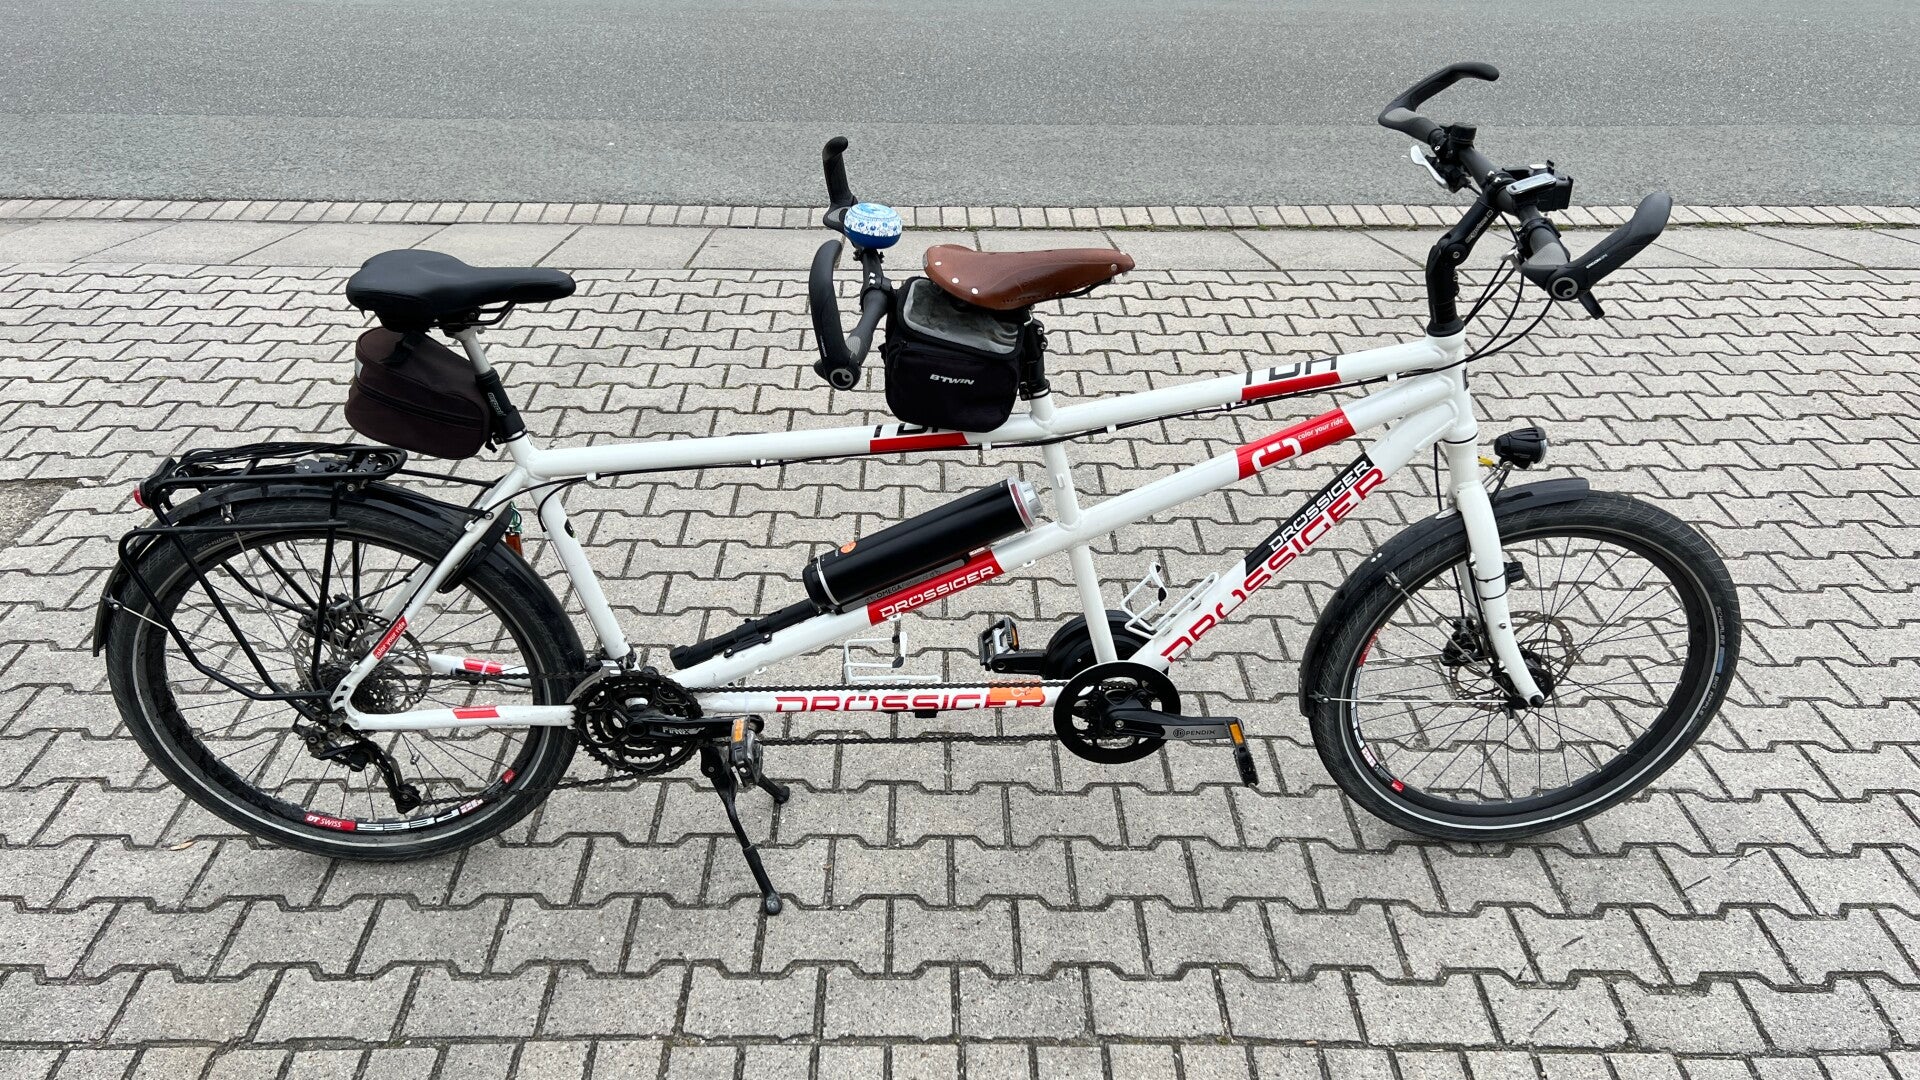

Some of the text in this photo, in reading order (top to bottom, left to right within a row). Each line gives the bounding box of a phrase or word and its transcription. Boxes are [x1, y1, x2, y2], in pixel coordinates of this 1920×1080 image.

[1297, 418, 1344, 440] color your ride
[306, 815, 320, 823] DT
[320, 817, 342, 828] SWISS
